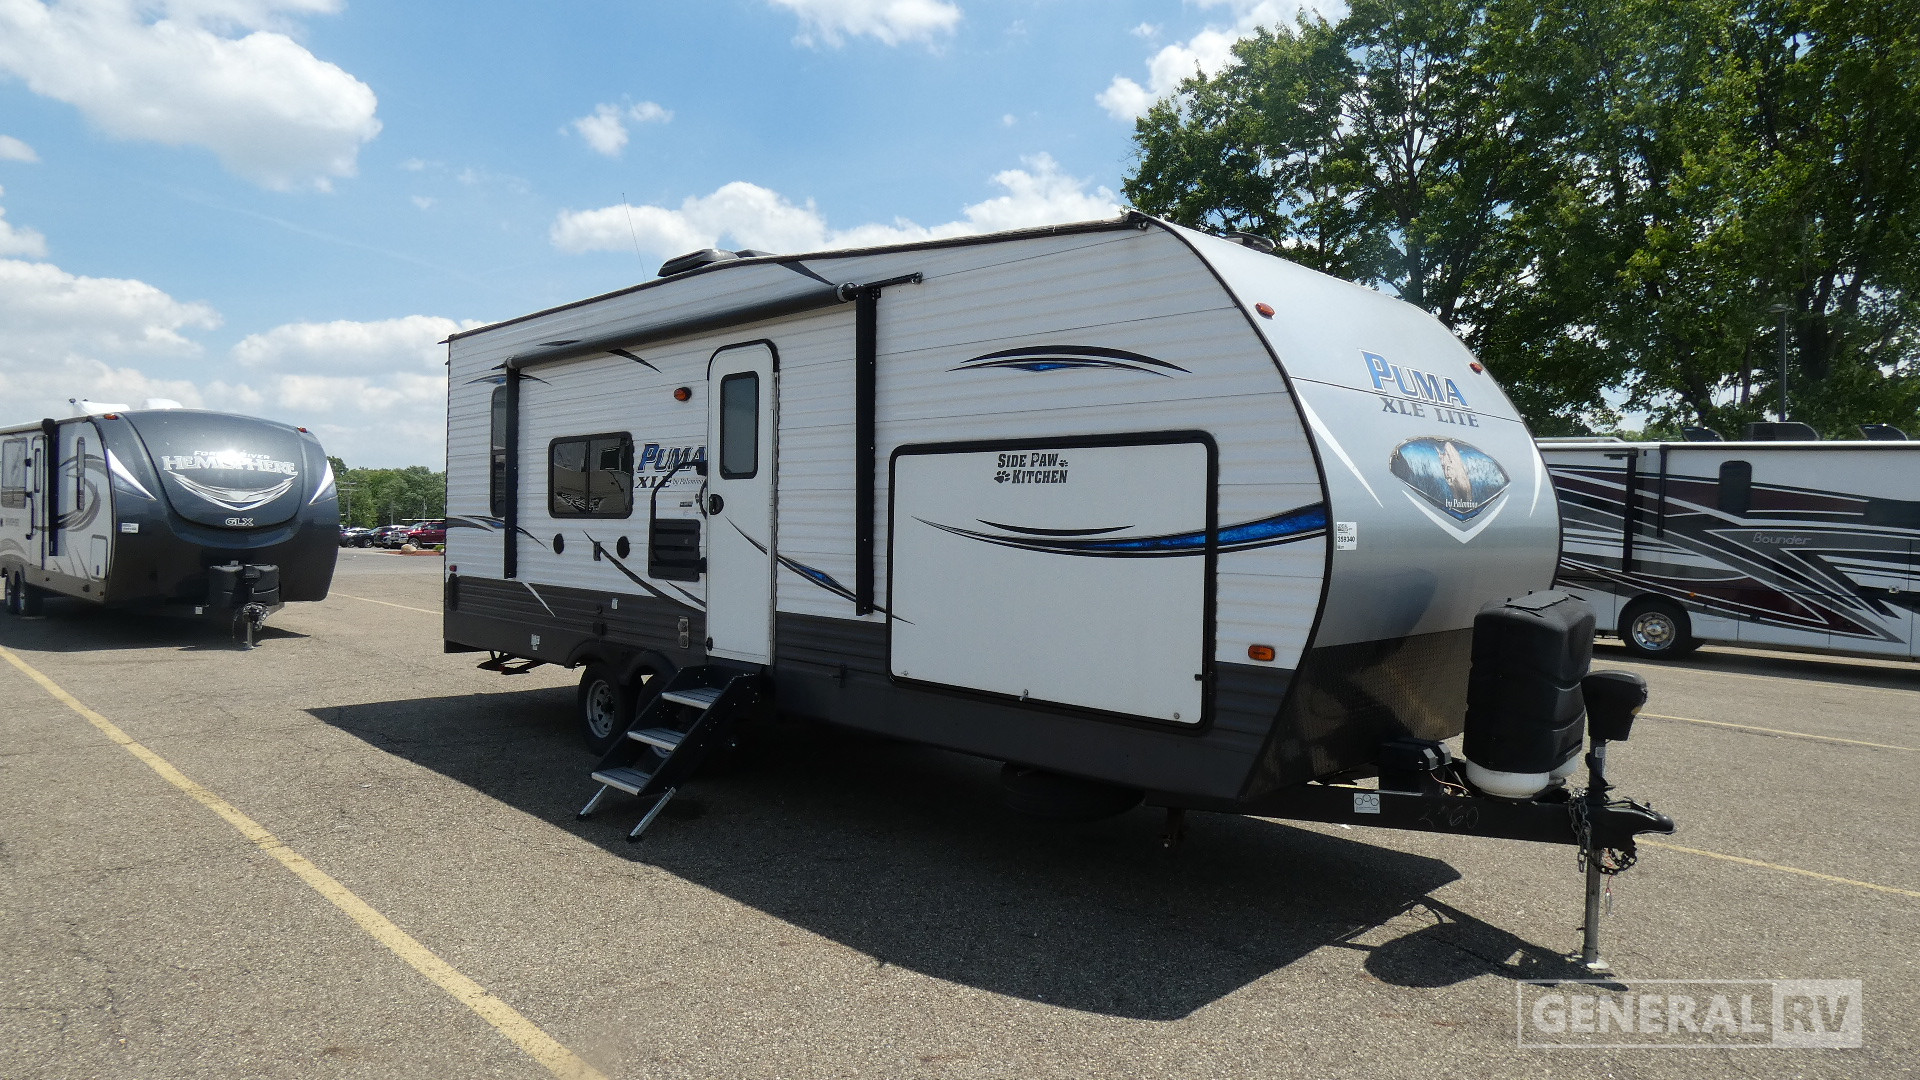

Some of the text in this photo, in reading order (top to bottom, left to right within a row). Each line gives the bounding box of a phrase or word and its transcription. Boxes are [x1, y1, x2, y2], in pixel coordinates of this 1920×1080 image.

[1360, 348, 1473, 411] PUMA
[1380, 396, 1480, 428] XLE LITE
[636, 441, 708, 473] PUMA
[997, 452, 1059, 469] SIDE PAW
[1011, 469, 1069, 484] KITCHEN
[225, 517, 254, 527] GLX
[1752, 531, 1813, 545] Bounder
